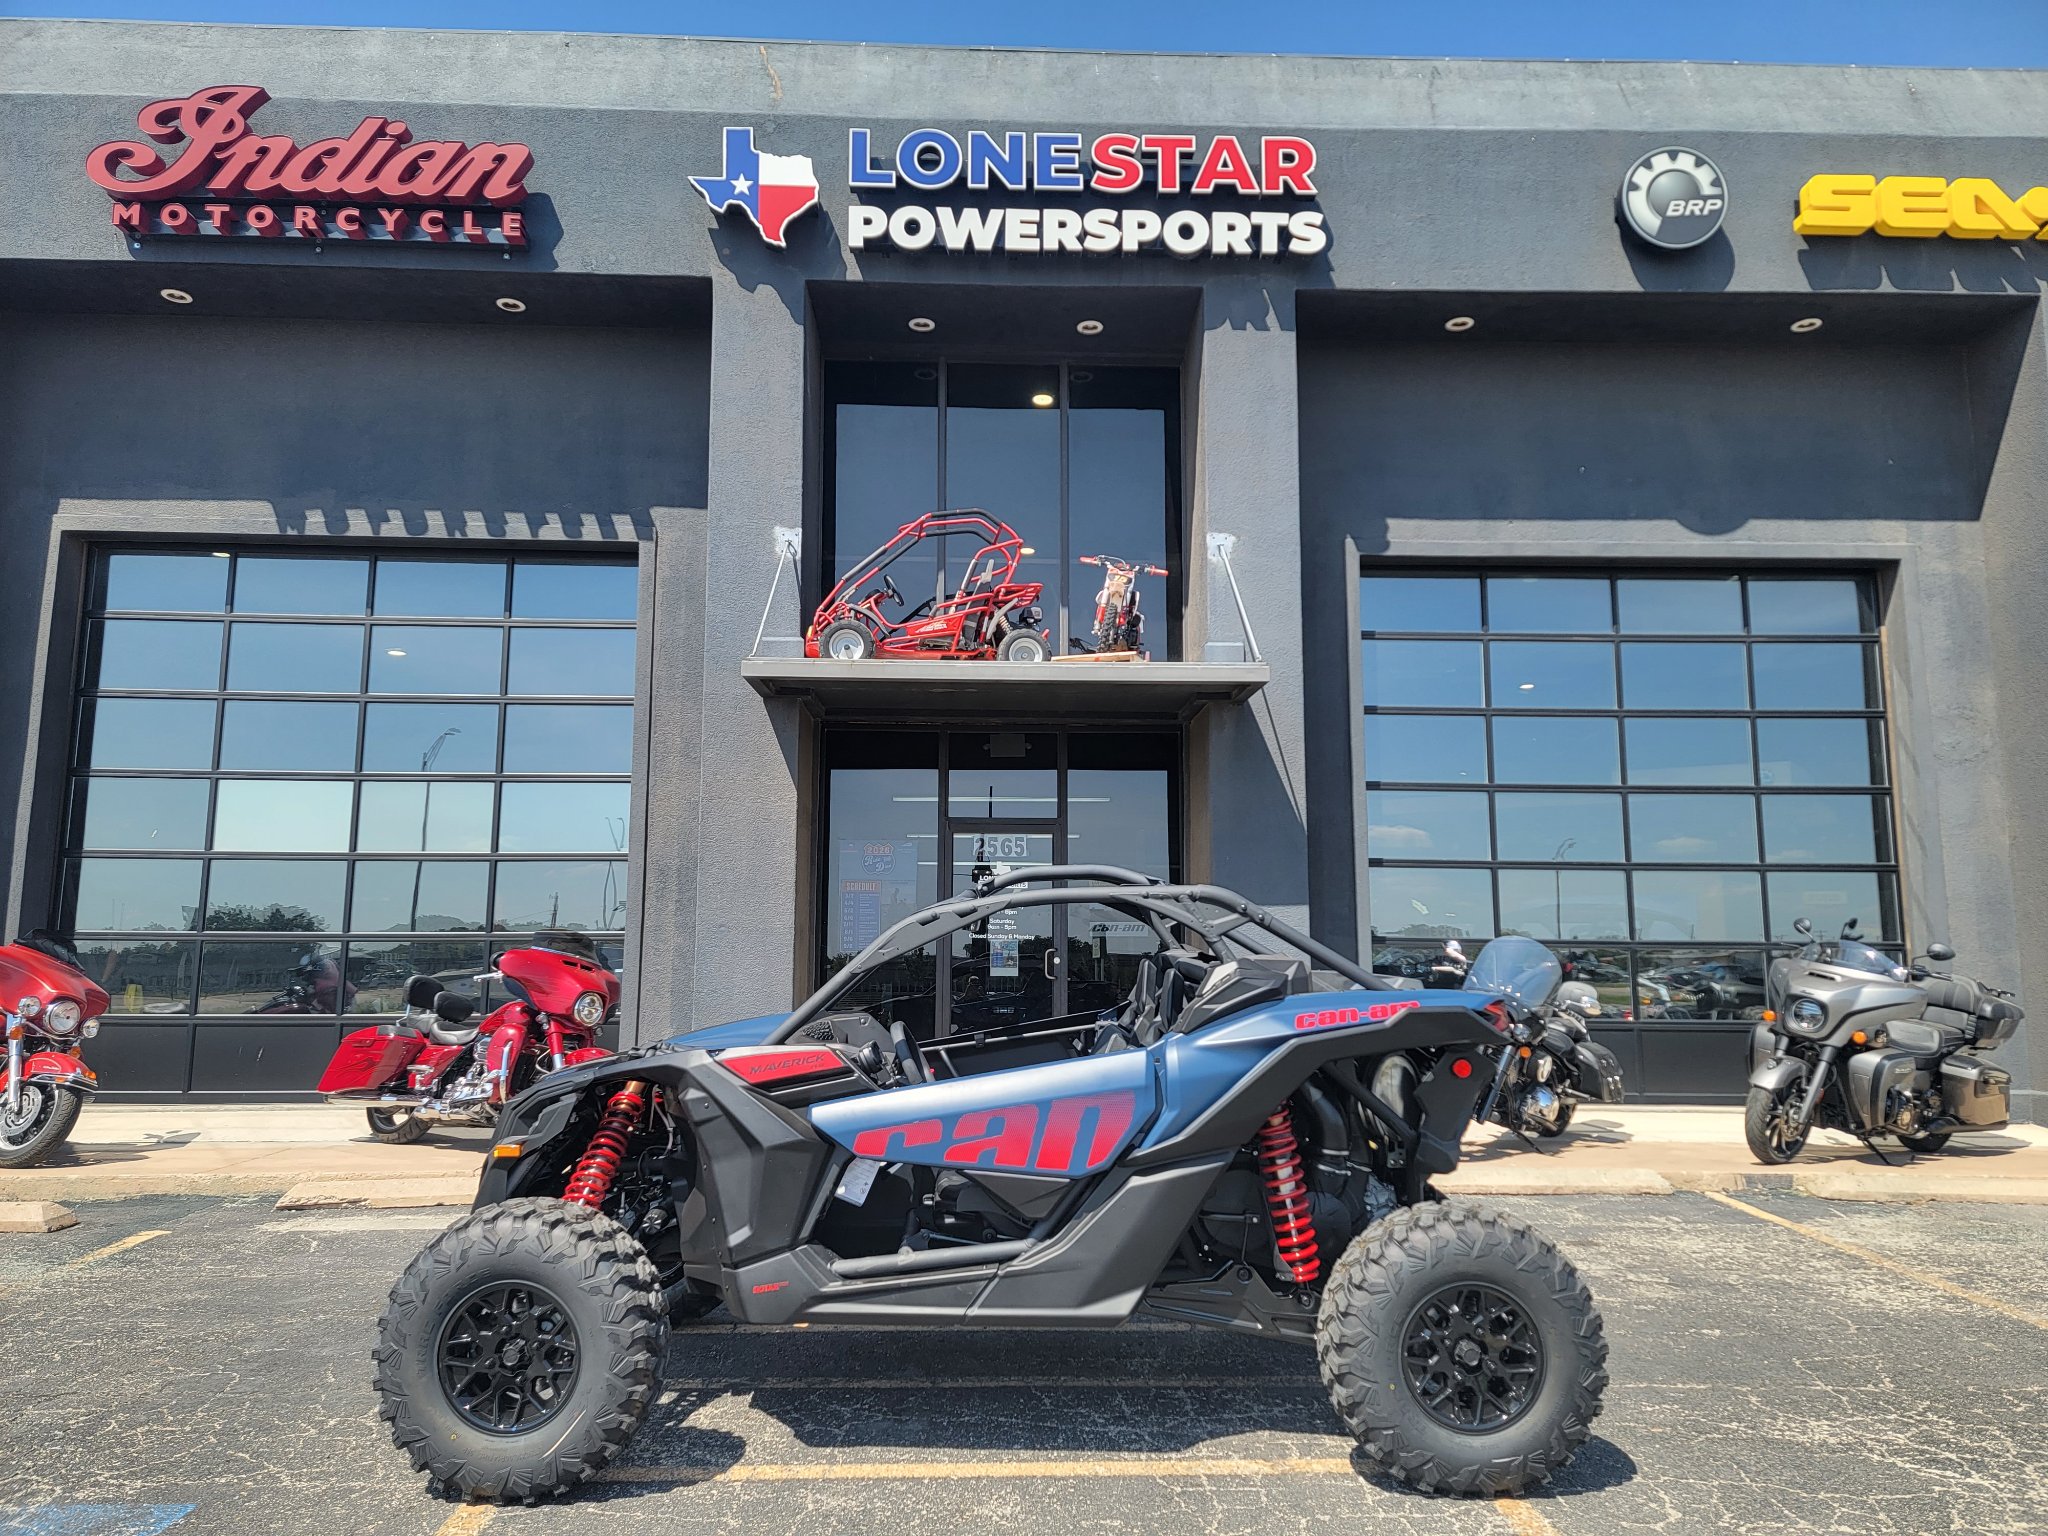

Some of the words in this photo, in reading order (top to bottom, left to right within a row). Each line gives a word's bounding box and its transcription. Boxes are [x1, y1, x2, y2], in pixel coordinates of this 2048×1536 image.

[86, 85, 534, 206] Indian
[847, 127, 1318, 197] LONESTAR
[1665, 199, 1723, 216] BRP
[111, 203, 526, 245] MOTORCYCLE
[847, 205, 1327, 258] POWERSPORTS
[974, 836, 1025, 857] 2565
[846, 881, 876, 891] SCHEDULE
[749, 1053, 826, 1075] MAVERICK
